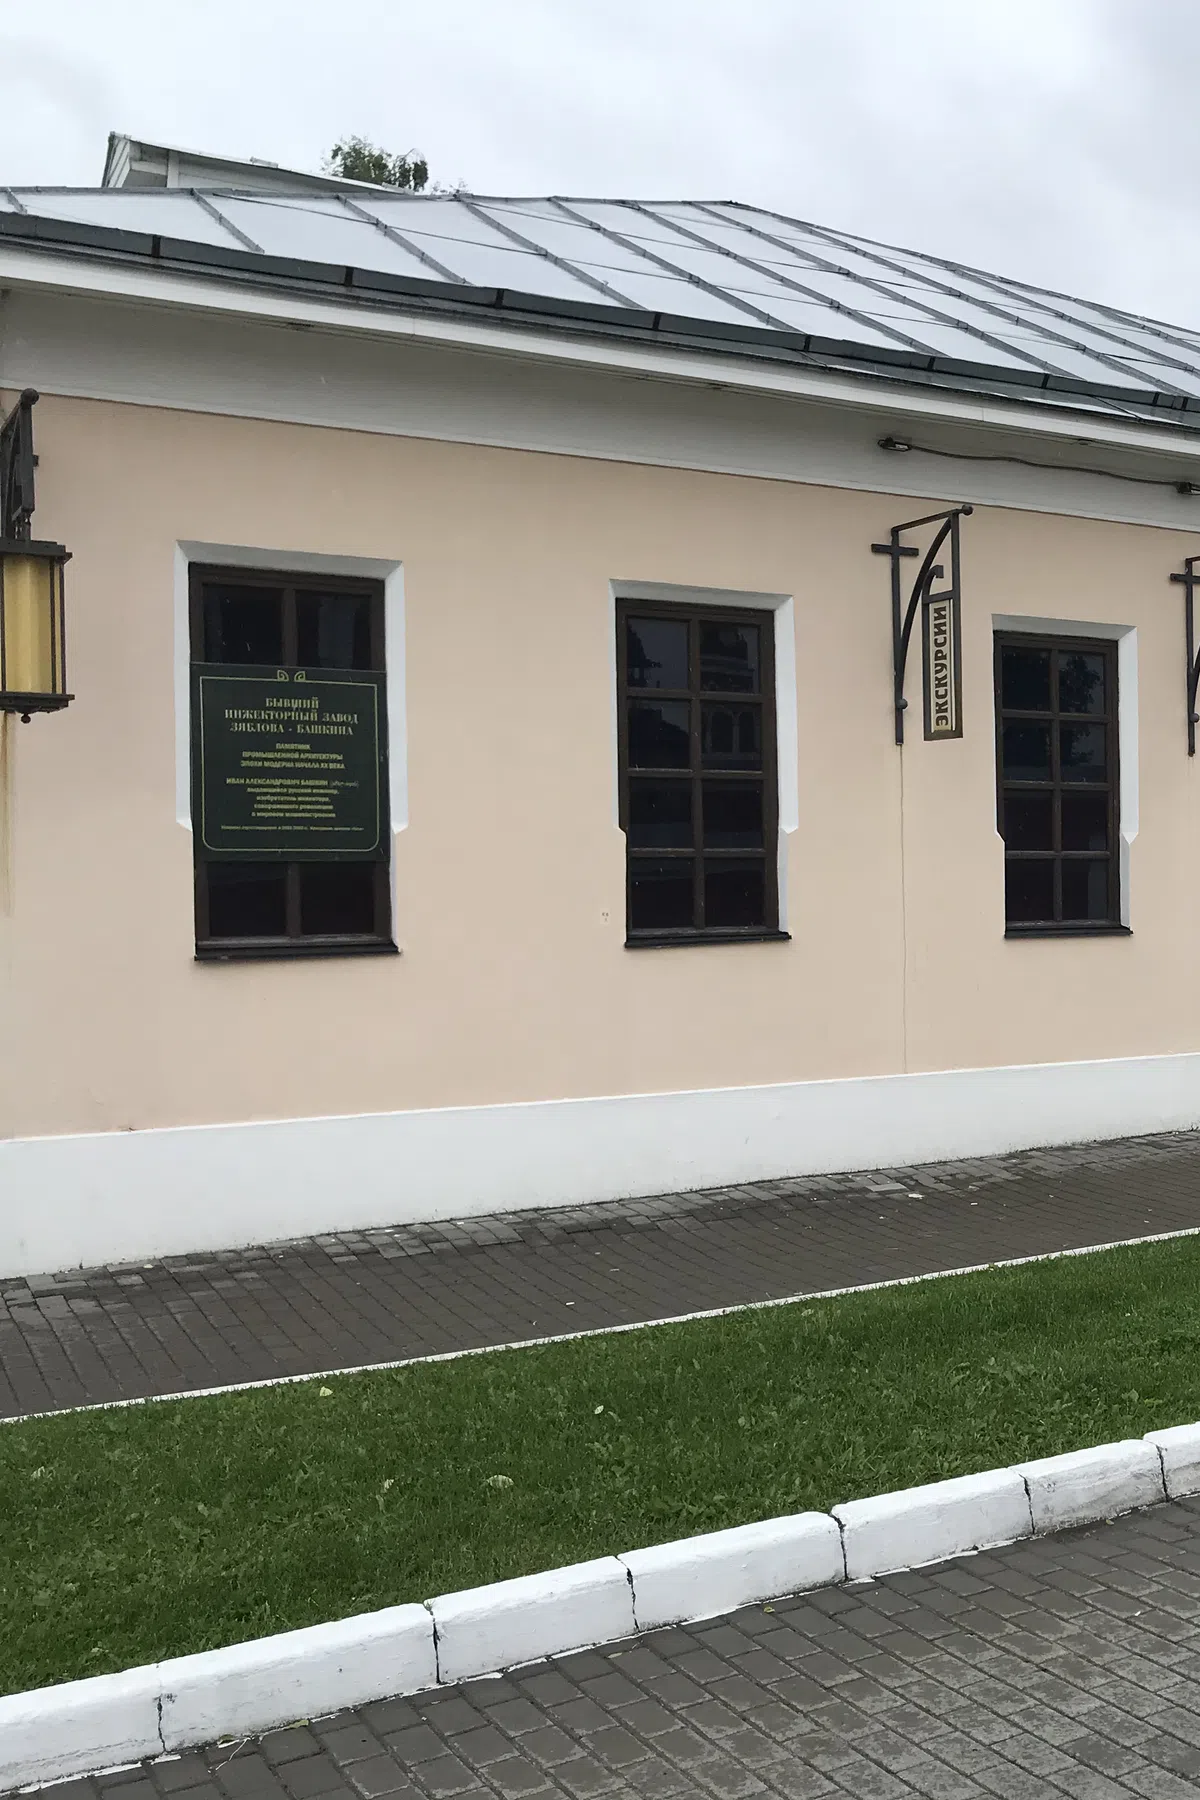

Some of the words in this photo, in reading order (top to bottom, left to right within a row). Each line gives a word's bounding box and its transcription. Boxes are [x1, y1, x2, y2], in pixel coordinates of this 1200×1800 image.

[933, 605, 948, 727] ЭКСКУРСИИ
[265, 697, 319, 709] БЫВШИЙ
[224, 709, 318, 721] ИНЖЕКТОРНЫЙ
[321, 713, 359, 724] ЗАВОД
[229, 722, 285, 733] ЗЯБЛОВА
[296, 725, 353, 735] БАШКИНА
